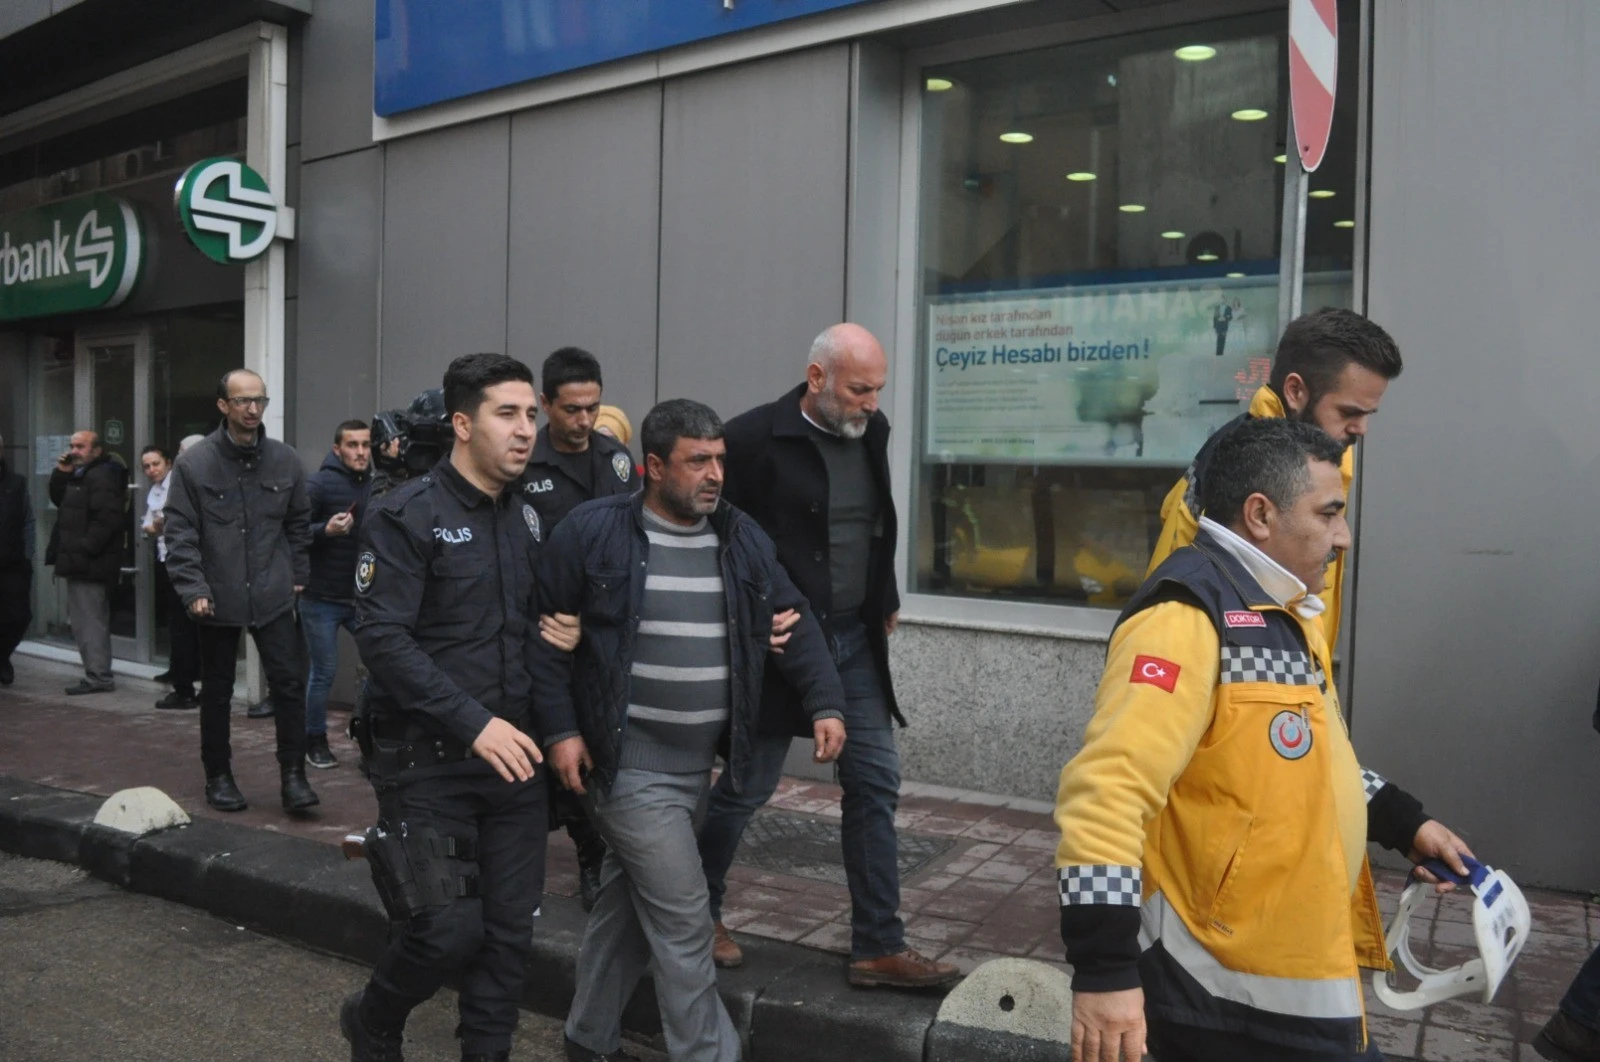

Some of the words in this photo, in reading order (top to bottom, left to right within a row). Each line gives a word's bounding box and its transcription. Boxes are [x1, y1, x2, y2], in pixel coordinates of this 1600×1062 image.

[990, 308, 1052, 323] tarafından
[973, 327, 1007, 340] erkek
[1010, 324, 1073, 338] tarafından
[936, 346, 987, 372] Çeyiz
[992, 342, 1061, 365] Hesabı
[1229, 614, 1262, 624] DOKTOR
